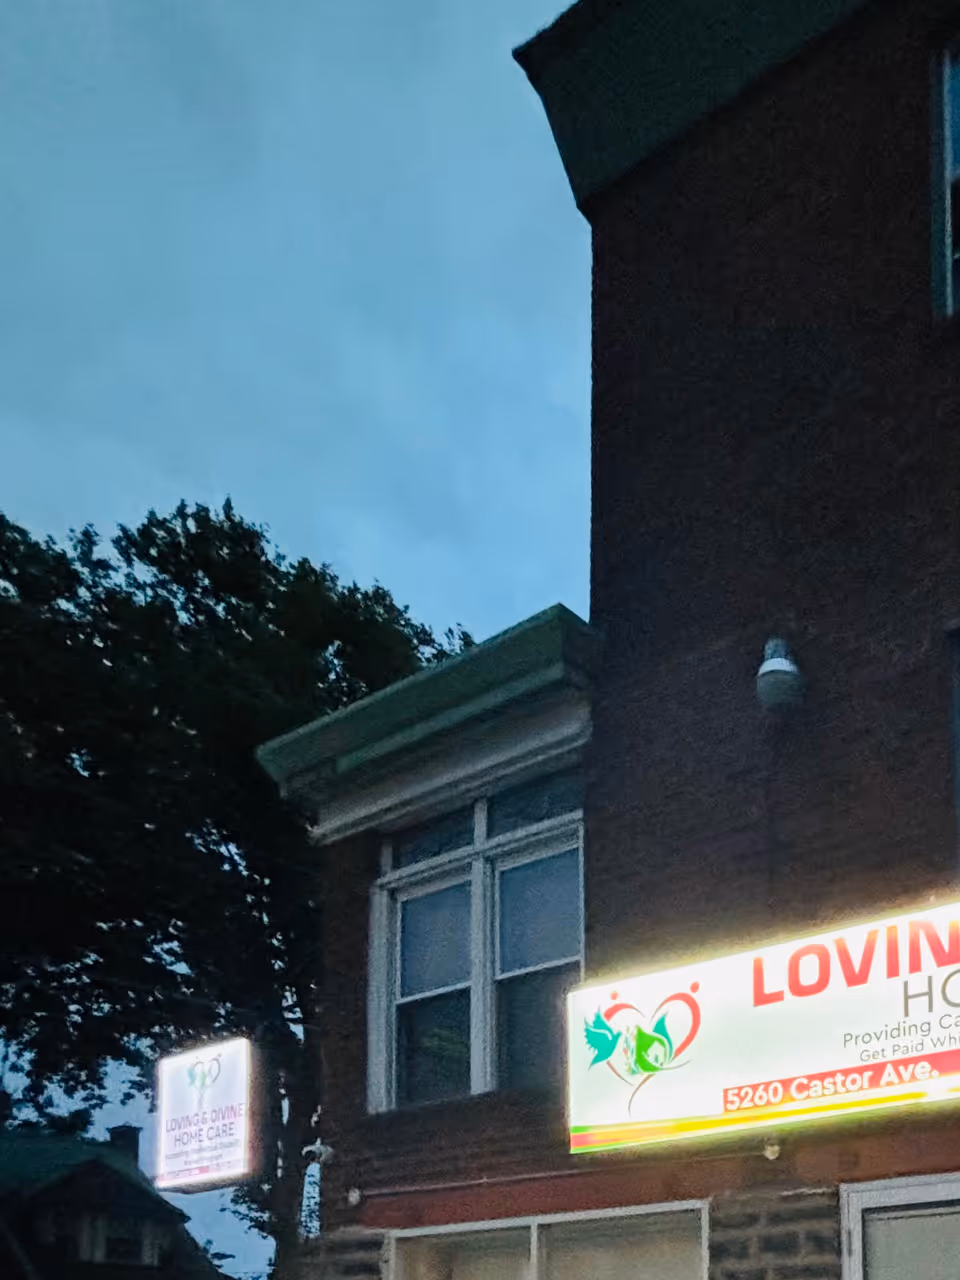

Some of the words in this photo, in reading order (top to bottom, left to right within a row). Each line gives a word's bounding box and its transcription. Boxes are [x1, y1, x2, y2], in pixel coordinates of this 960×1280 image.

[843, 1020, 931, 1048] Providing
[859, 1048, 886, 1062] Get
[892, 1039, 924, 1056] Paid
[726, 1081, 783, 1111] 5260
[790, 1070, 873, 1099] Castor
[880, 1059, 939, 1086] Ave.
[165, 1112, 200, 1133] LOVING
[211, 1103, 246, 1123] DIVINE
[174, 1128, 204, 1148] HOME
[206, 1121, 235, 1141] CARE
